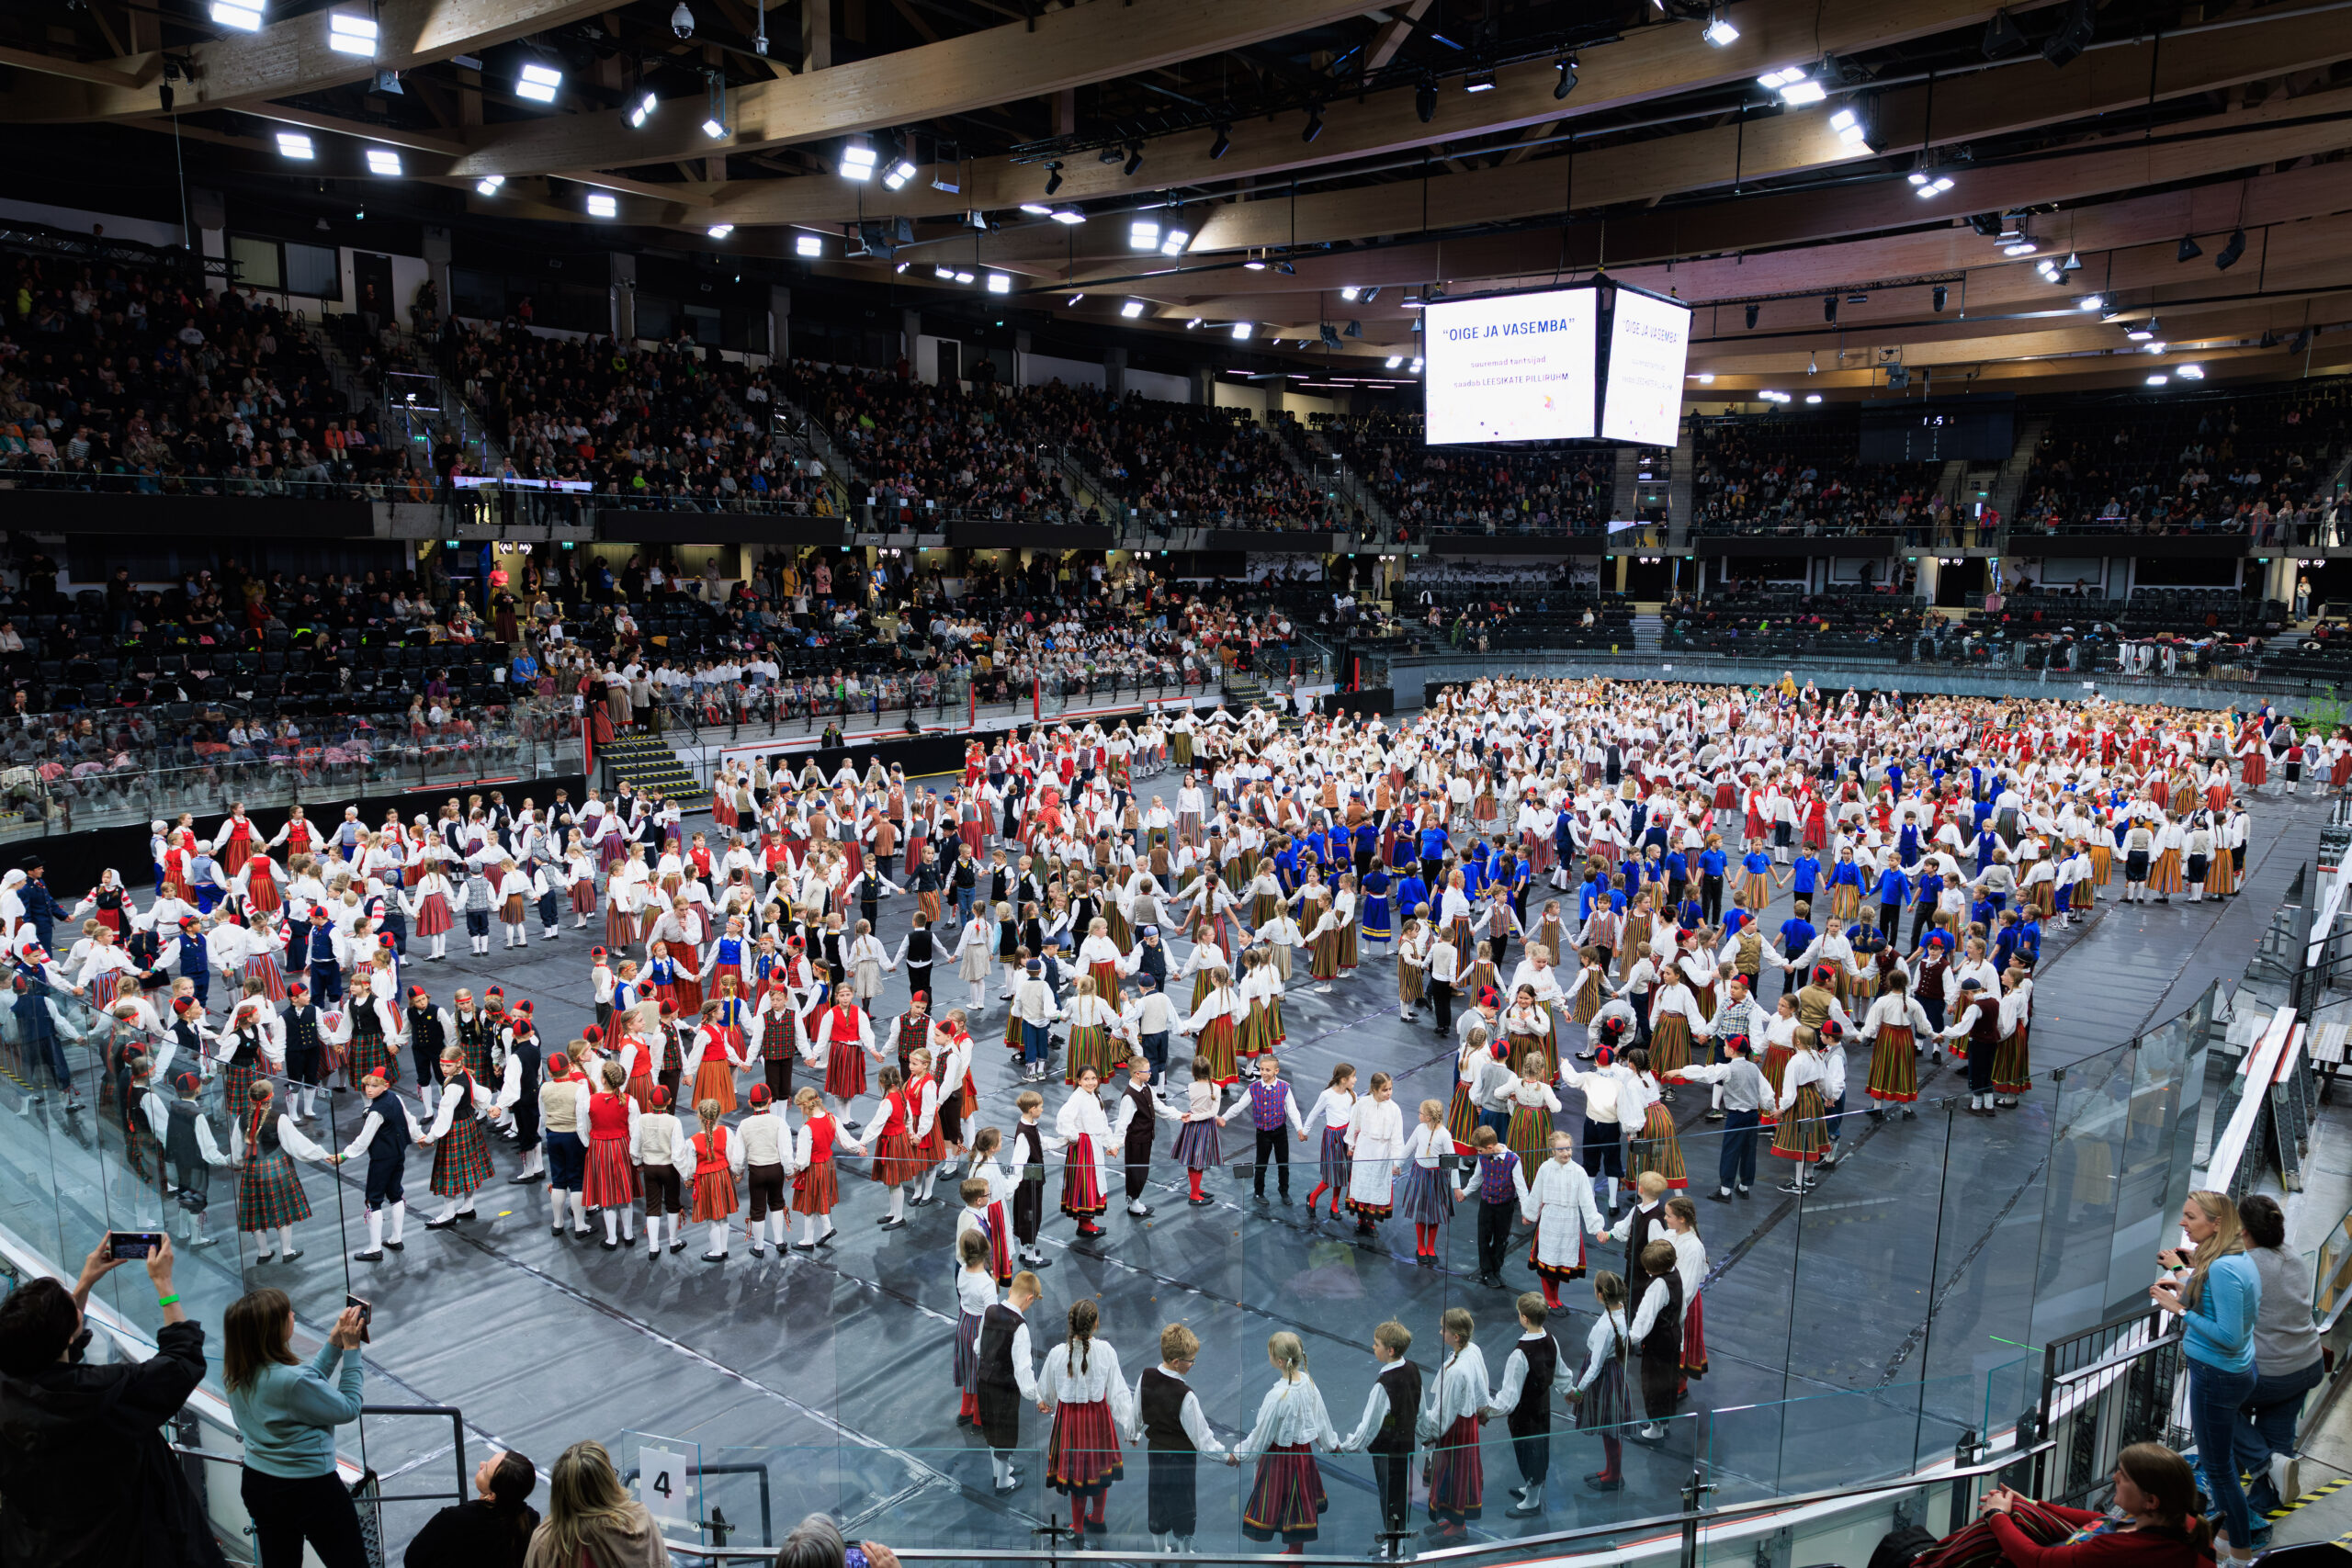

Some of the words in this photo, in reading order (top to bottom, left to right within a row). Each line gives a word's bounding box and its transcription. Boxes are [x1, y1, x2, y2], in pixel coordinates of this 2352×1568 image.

[1483, 325, 1498, 338] JA
[1470, 358, 1509, 368] suuremad
[1510, 355, 1546, 367] tantsijad
[1453, 379, 1481, 389] saadab
[1482, 375, 1523, 386] LEESIKATE
[653, 1471, 672, 1499] 4
